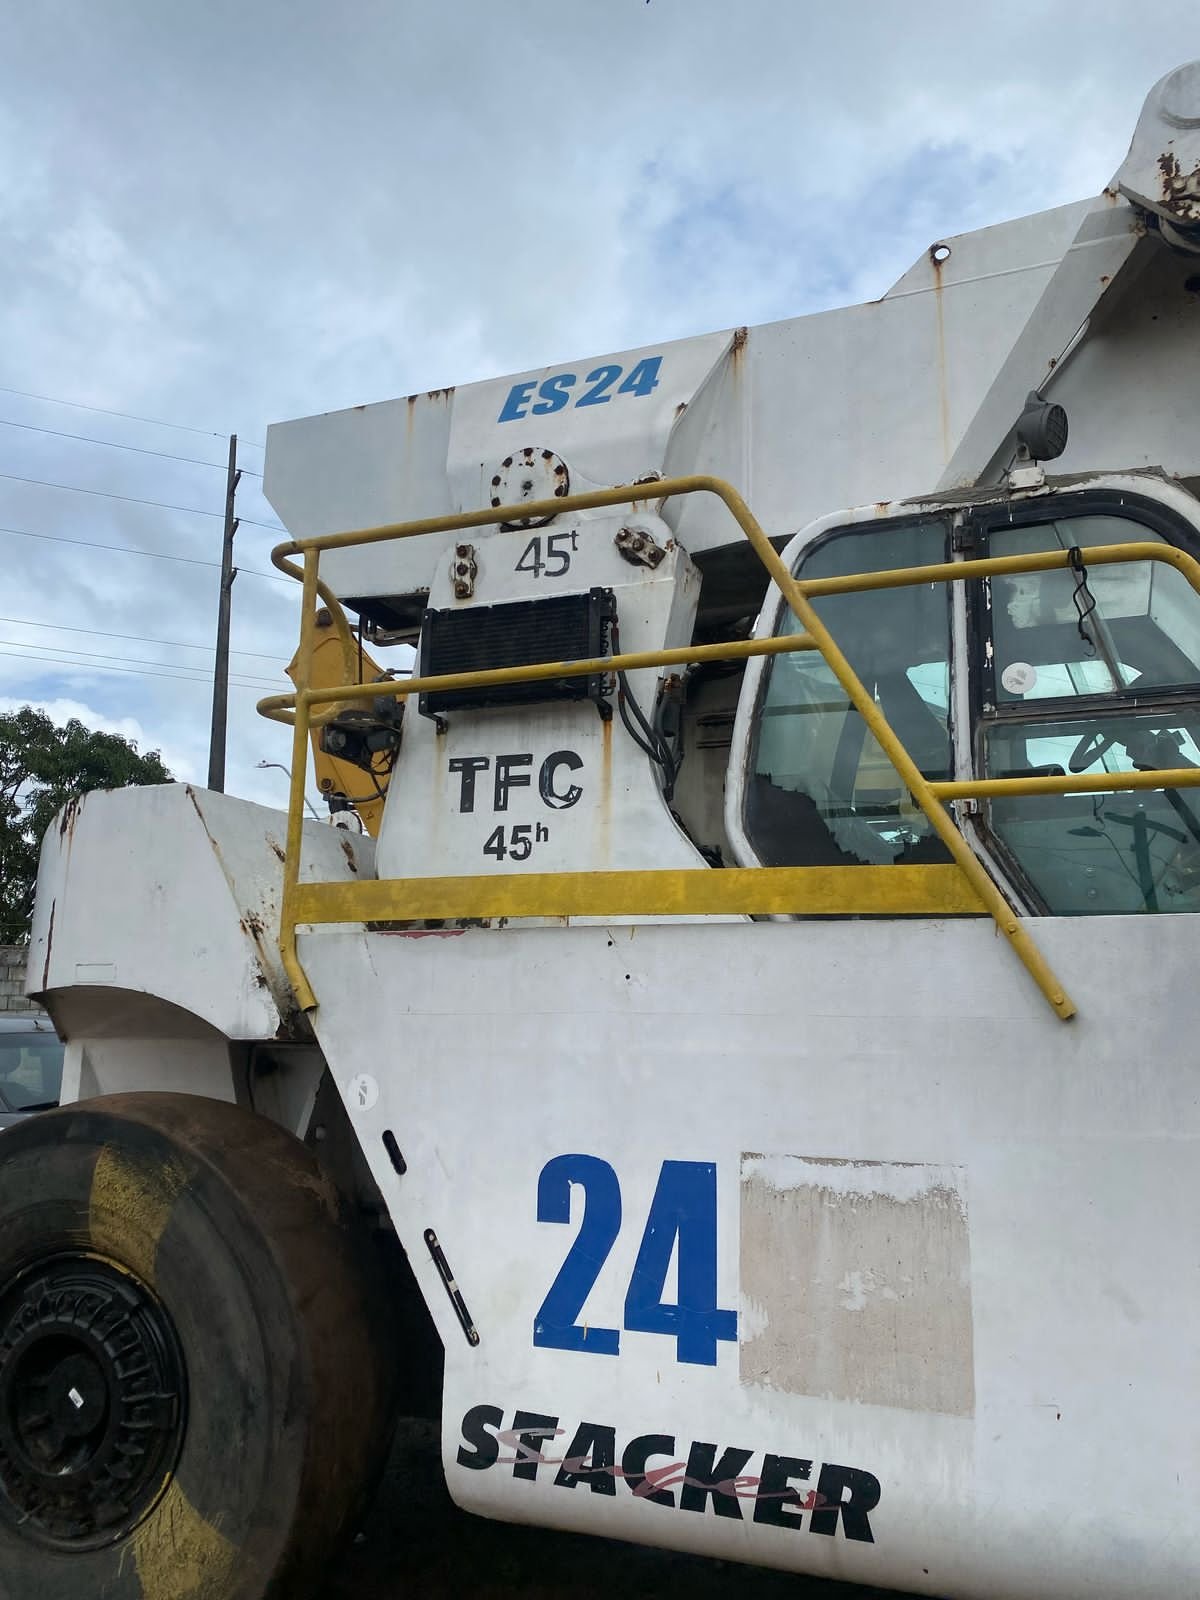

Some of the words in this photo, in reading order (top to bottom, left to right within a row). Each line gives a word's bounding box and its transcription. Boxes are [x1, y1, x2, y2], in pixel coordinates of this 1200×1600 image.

[498, 356, 663, 423] ES24
[449, 750, 583, 813] TFC
[533, 1154, 738, 1366] 24
[457, 1405, 882, 1543] STACKER
